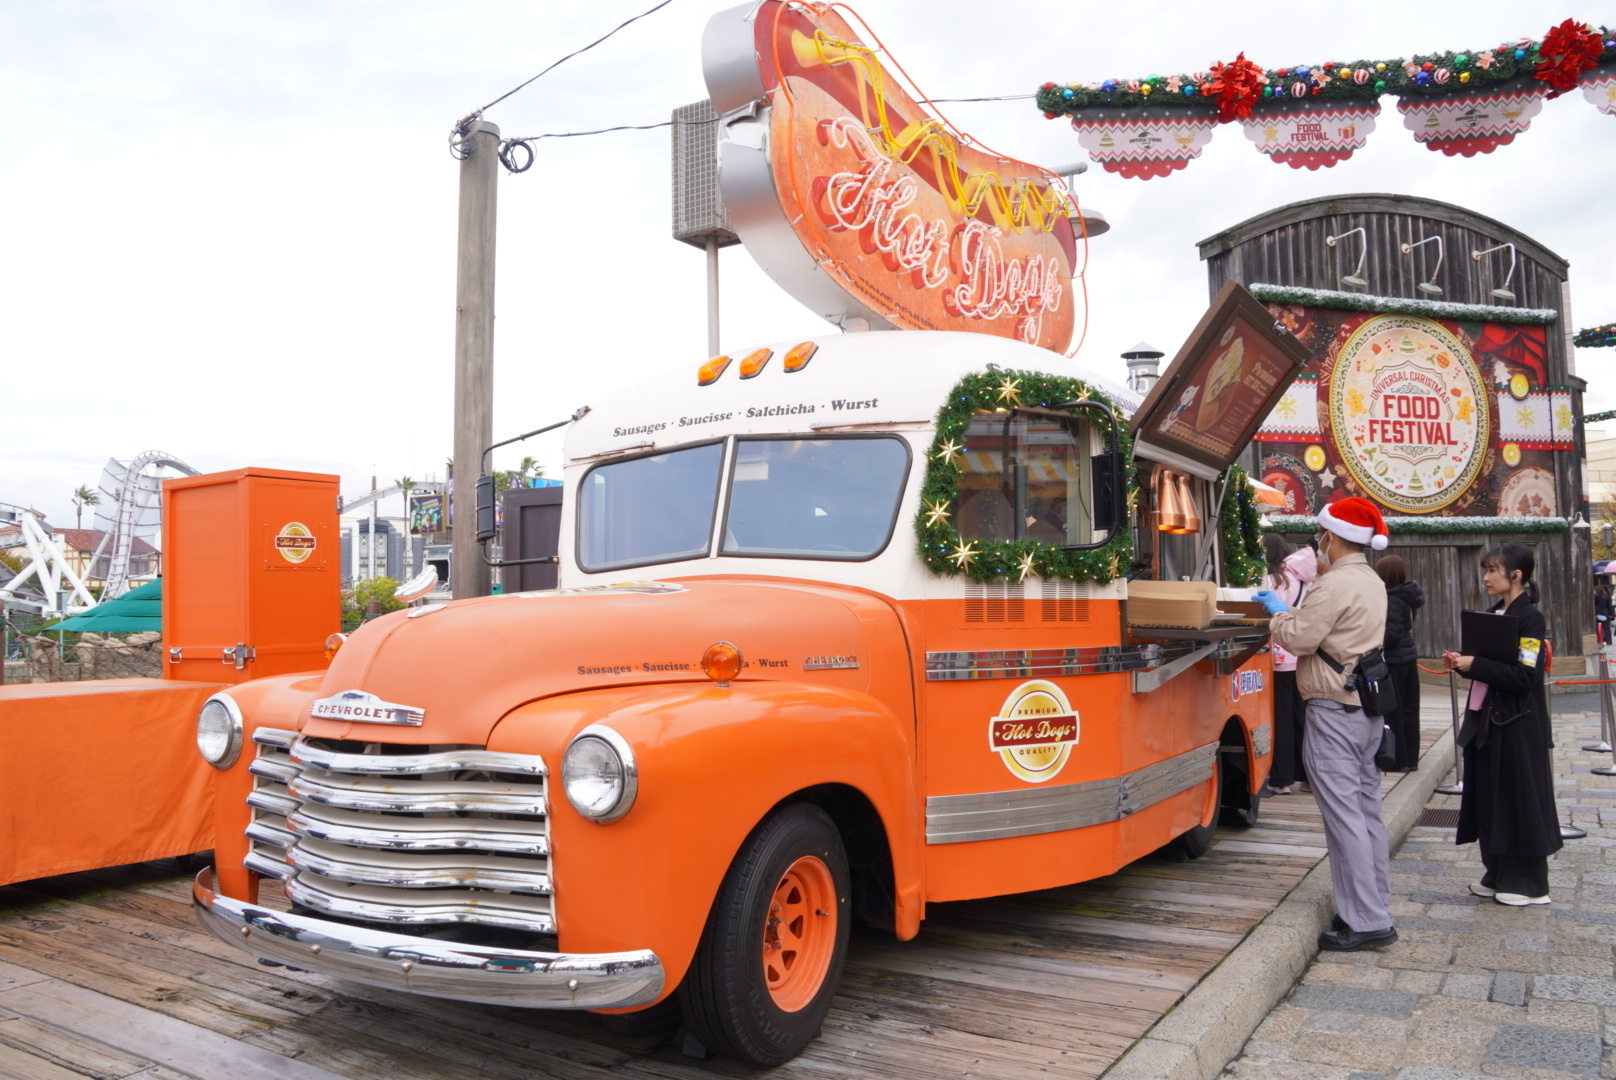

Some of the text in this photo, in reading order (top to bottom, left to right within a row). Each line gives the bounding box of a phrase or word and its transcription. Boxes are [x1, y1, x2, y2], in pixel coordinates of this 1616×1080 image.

[1297, 123, 1322, 133] FOOD
[1291, 132, 1329, 142] FESTIVAL
[815, 116, 1063, 347] Hot Dogs
[1131, 368, 1149, 394] 15
[1370, 371, 1451, 404] UNIVERSAL CHRISTMAS
[1383, 394, 1440, 420] FOOD
[613, 398, 879, 437] Sausages Saucisse Salchicha Wurst
[1368, 419, 1458, 446] FESTIVAL
[279, 537, 312, 549] Hot Dogs
[577, 665, 632, 675] Sausages
[642, 662, 689, 672] Saucisse
[758, 658, 788, 668] Wurst
[317, 704, 396, 720] CHEVROLET
[1018, 707, 1057, 716] PREMIUM
[1002, 720, 1071, 742] Hot Dogs
[1019, 746, 1057, 756] QUALITY
